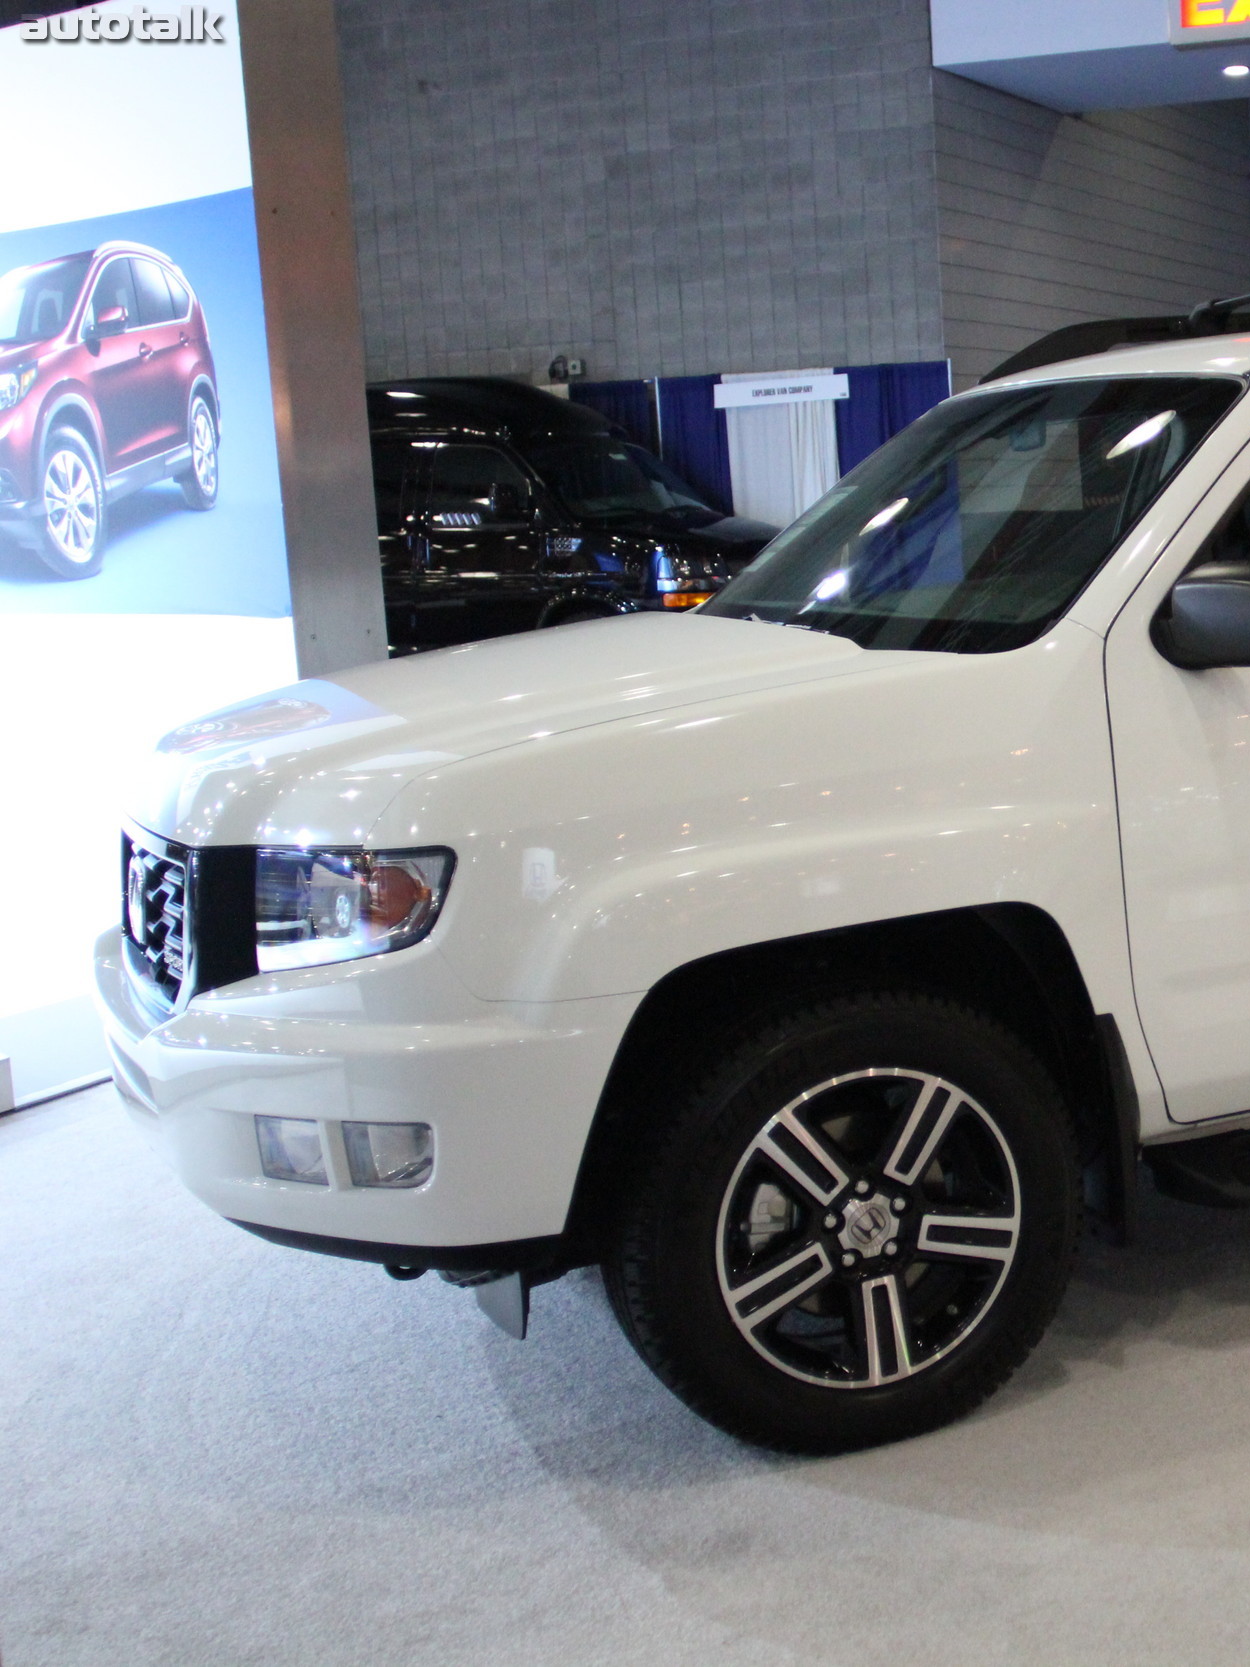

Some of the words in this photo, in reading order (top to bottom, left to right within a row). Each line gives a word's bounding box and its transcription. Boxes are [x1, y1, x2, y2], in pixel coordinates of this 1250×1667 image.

[752, 388, 776, 397] EXPLORER
[777, 387, 787, 395] VAN
[788, 385, 813, 394] COMPANY
